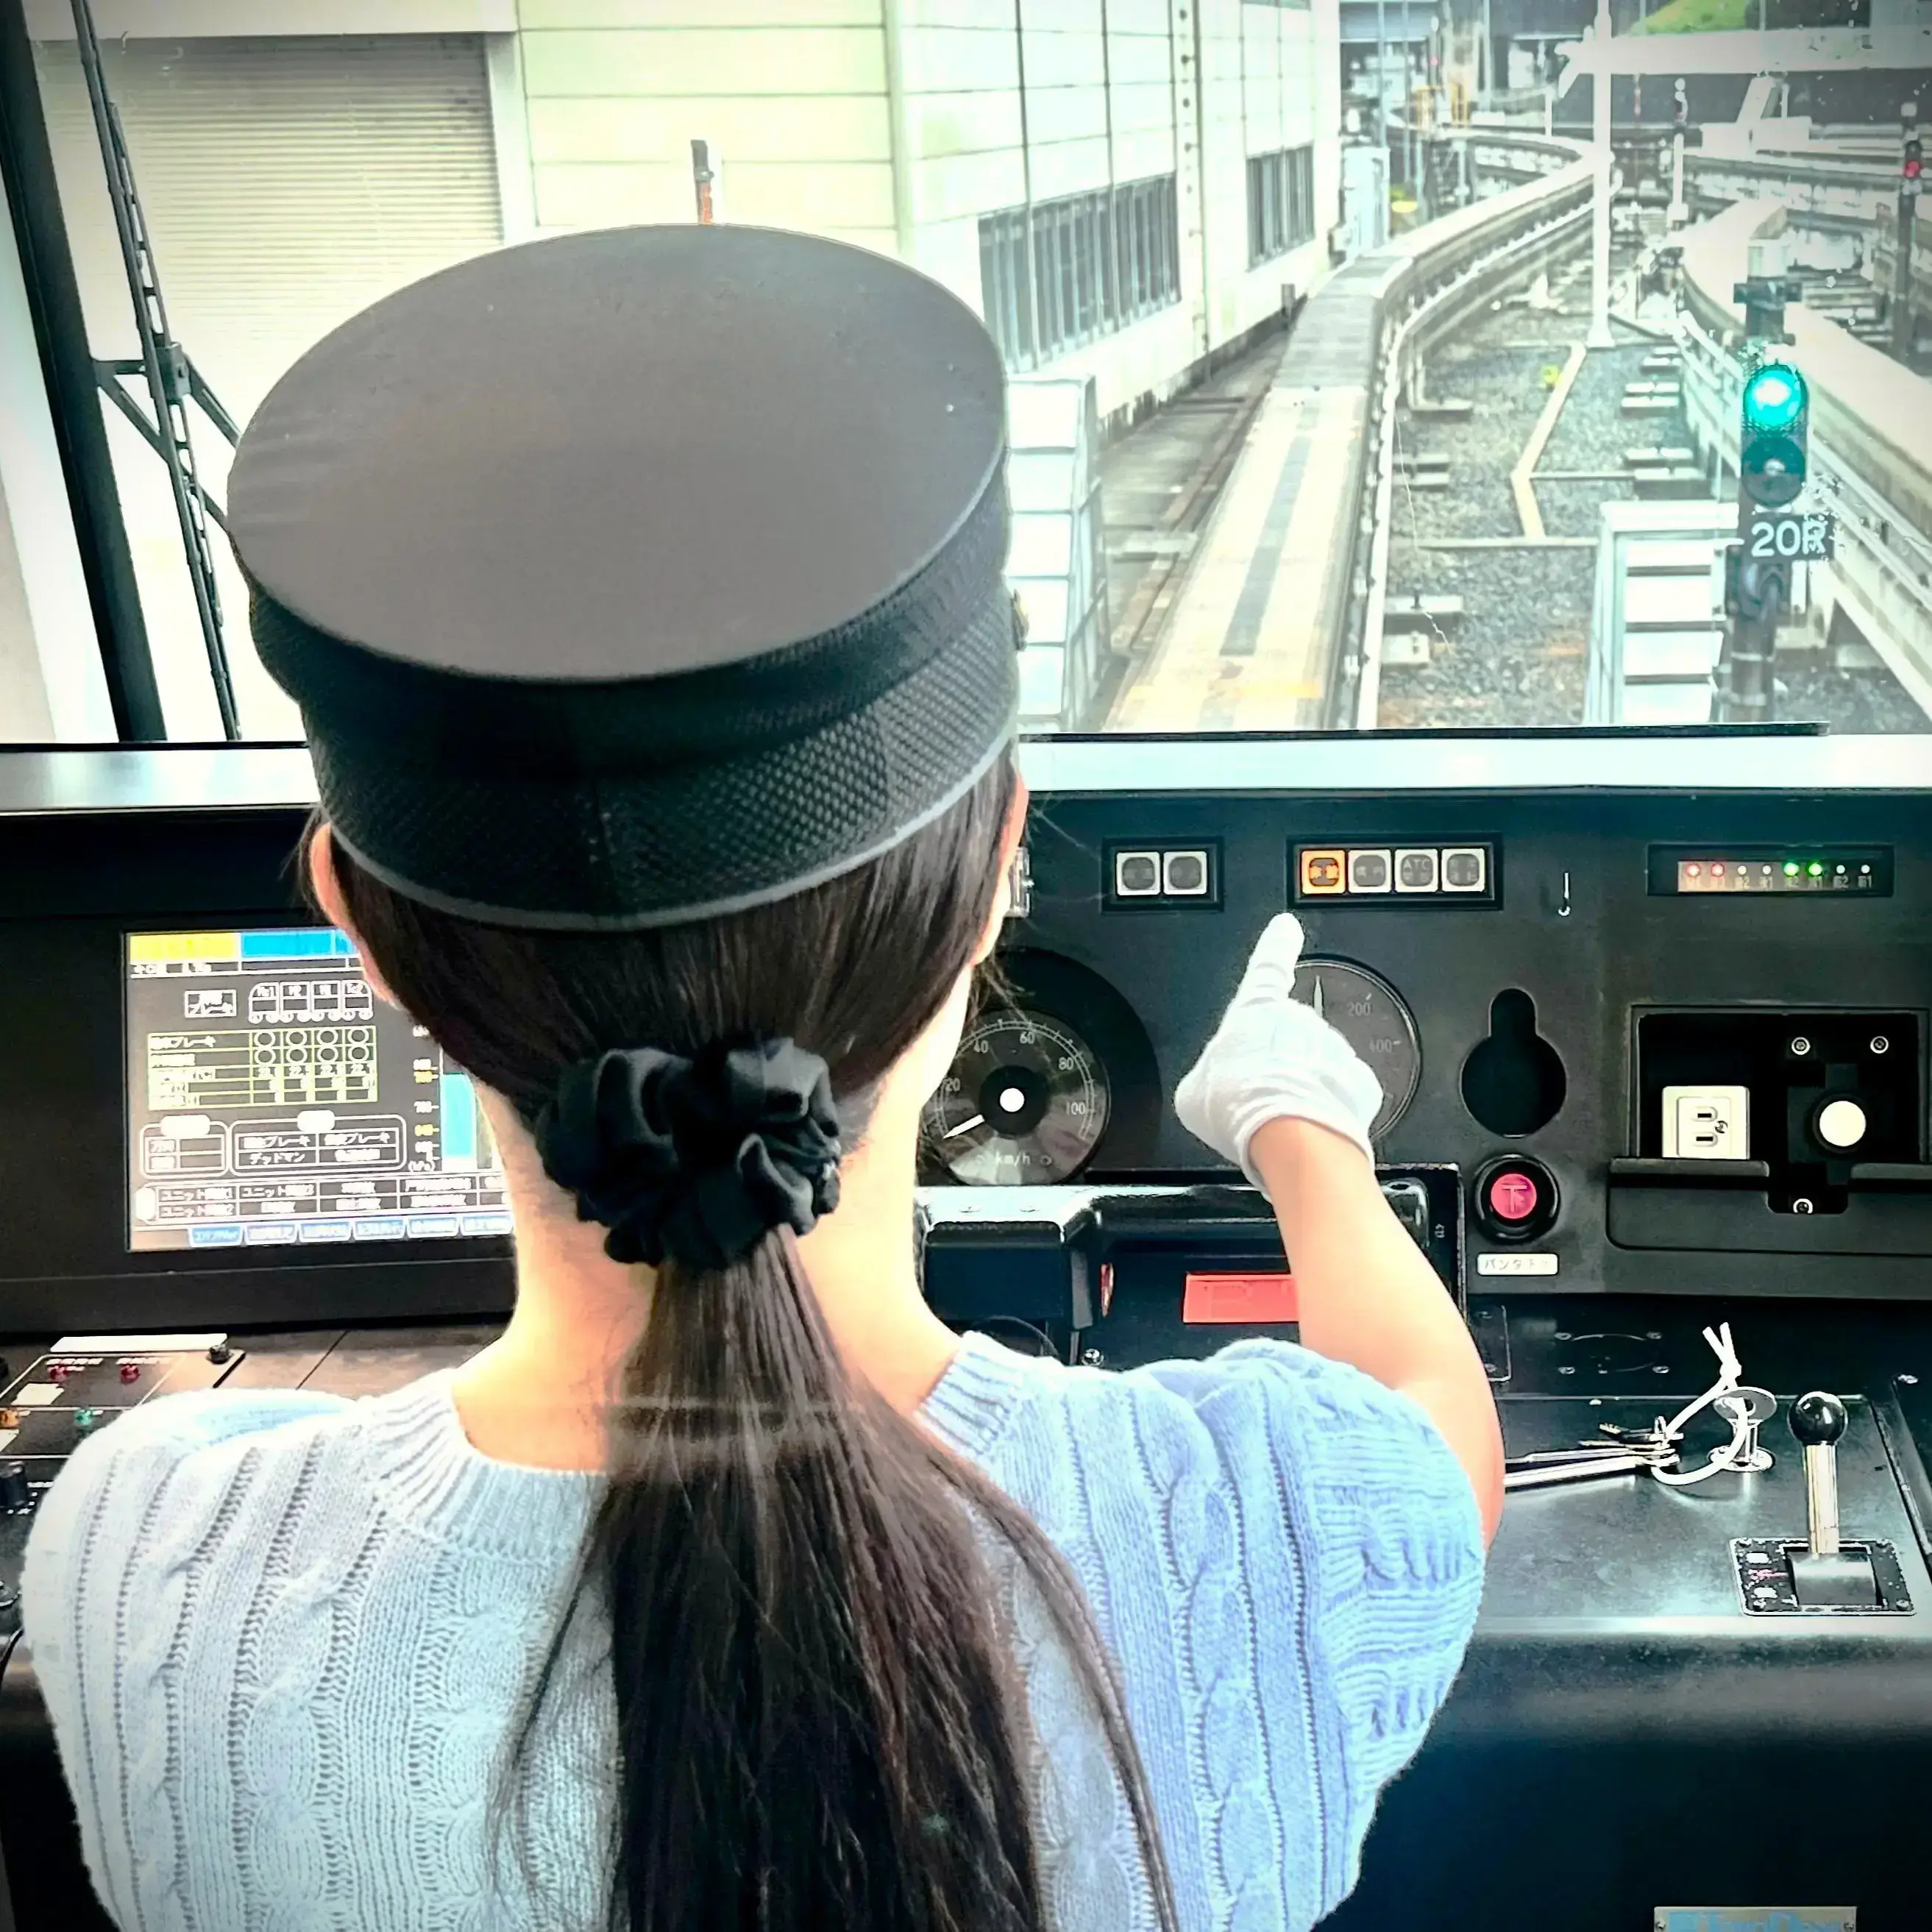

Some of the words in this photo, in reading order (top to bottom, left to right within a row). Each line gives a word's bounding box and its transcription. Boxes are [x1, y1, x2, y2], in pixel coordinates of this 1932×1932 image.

[1751, 520, 1826, 557] 20R
[1402, 859, 1431, 870] ATC
[1348, 1002, 1371, 1016] 200
[1020, 1031, 1035, 1044] 60
[973, 1040, 988, 1054] 40
[1058, 1056, 1073, 1070] 80
[945, 1078, 961, 1092] 20
[1067, 1102, 1086, 1115] 100
[244, 1135, 310, 1148] ブレーキ
[995, 1152, 1030, 1166] km/h
[161, 1187, 233, 1201] ユニット1
[1502, 1185, 1528, 1212] 下
[161, 1204, 235, 1218] ユニット2
